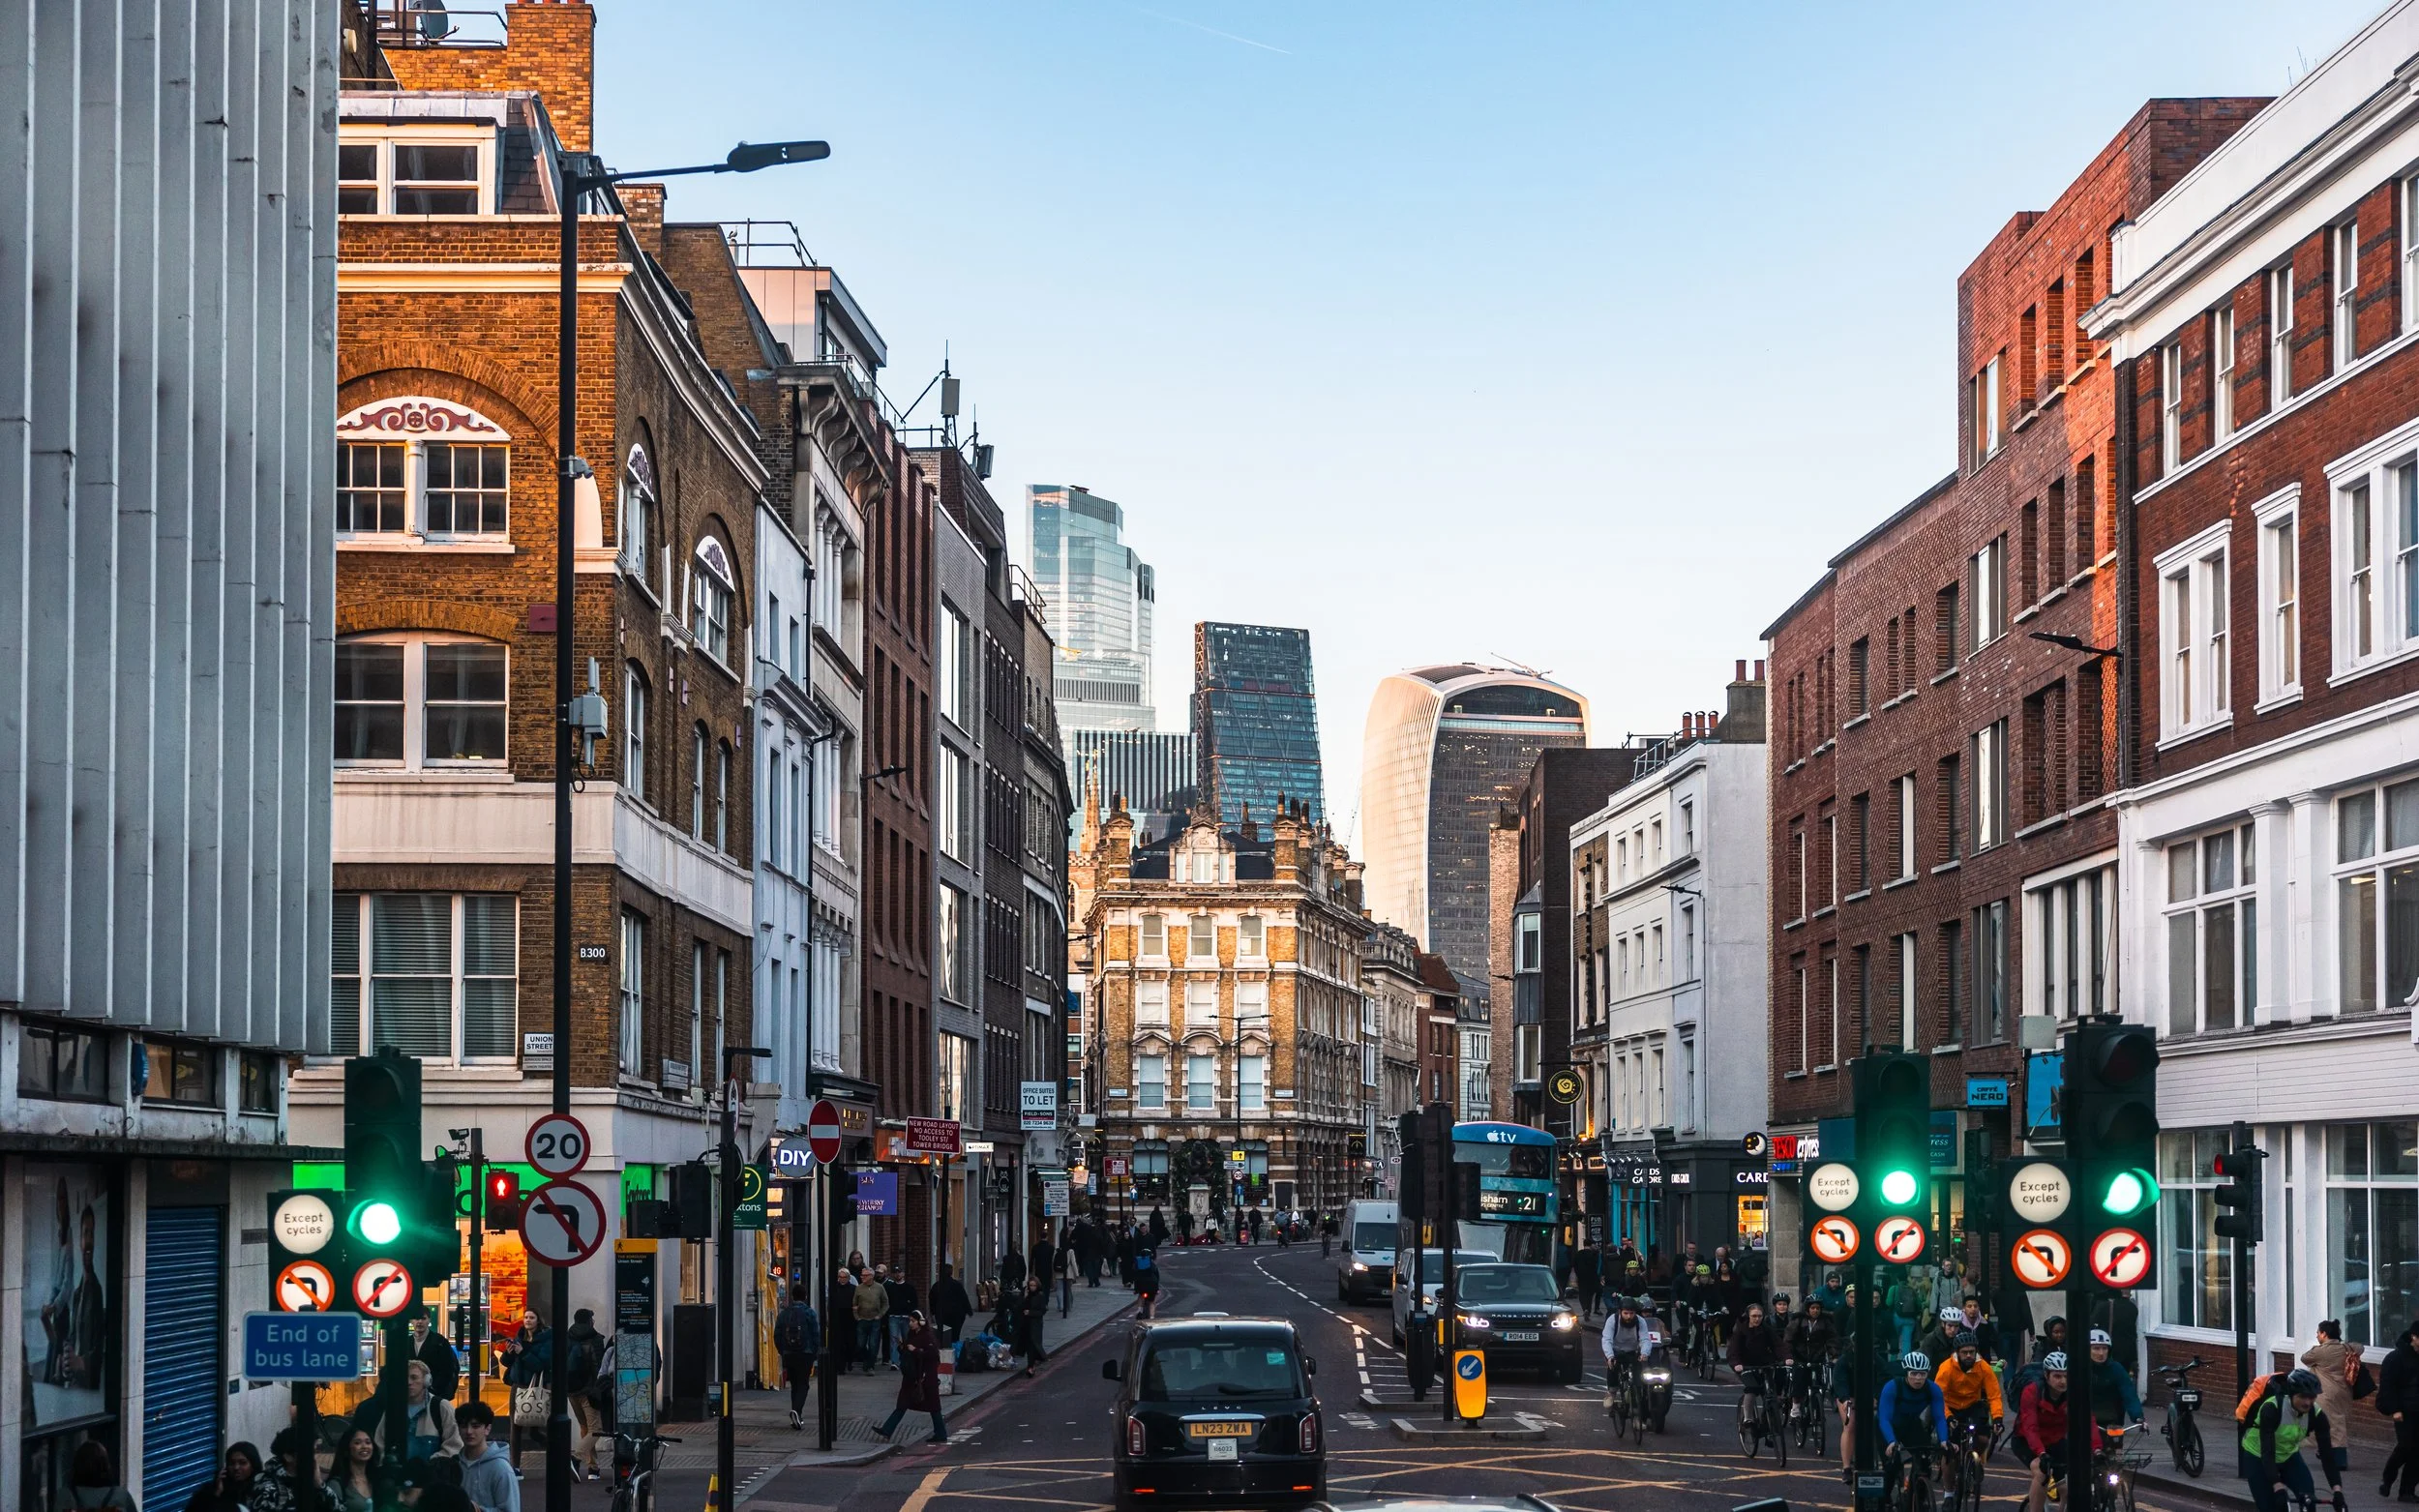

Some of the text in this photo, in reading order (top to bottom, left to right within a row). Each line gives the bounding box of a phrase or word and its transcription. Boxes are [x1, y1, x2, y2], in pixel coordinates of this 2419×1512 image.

[1022, 1095, 1054, 1105] TO LET
[1500, 1132, 1517, 1143] tv
[536, 1133, 581, 1159] 20
[1773, 1136, 1797, 1159] TESCO
[780, 1149, 812, 1166] DIY
[1632, 1175, 1662, 1184] GAORE
[1736, 1172, 1768, 1182] CARD
[1817, 1178, 1850, 1188] Except
[2020, 1181, 2060, 1193] Except
[1819, 1188, 1849, 1197] cycles
[1480, 1195, 1536, 1210] isham 21
[2022, 1193, 2059, 1204] cycles
[284, 1213, 323, 1223] Except
[286, 1225, 322, 1235] cycles
[267, 1324, 341, 1343] End of
[255, 1349, 348, 1367] bus lane
[1195, 1424, 1247, 1434] LN23 ZWA
